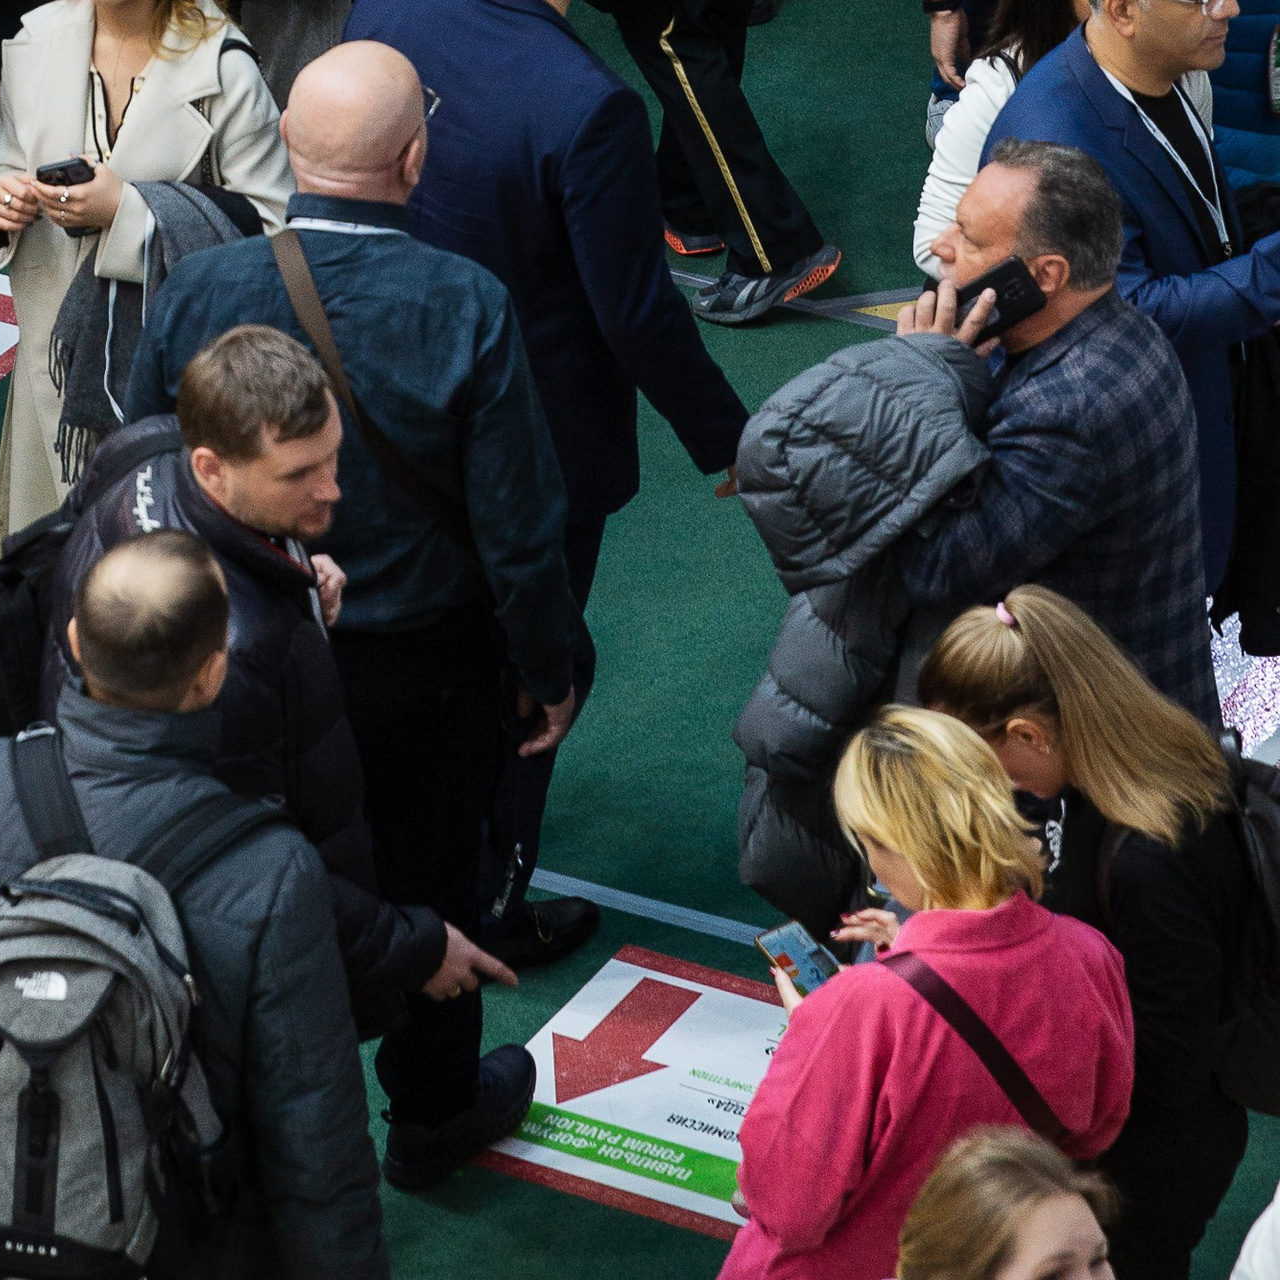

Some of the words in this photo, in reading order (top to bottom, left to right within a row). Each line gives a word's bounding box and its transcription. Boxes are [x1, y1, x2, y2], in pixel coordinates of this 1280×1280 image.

[544, 1113, 624, 1144] PAVILION
[597, 1144, 693, 1182] ПАВИЛЬОН
[620, 1133, 686, 1164] FORUM
